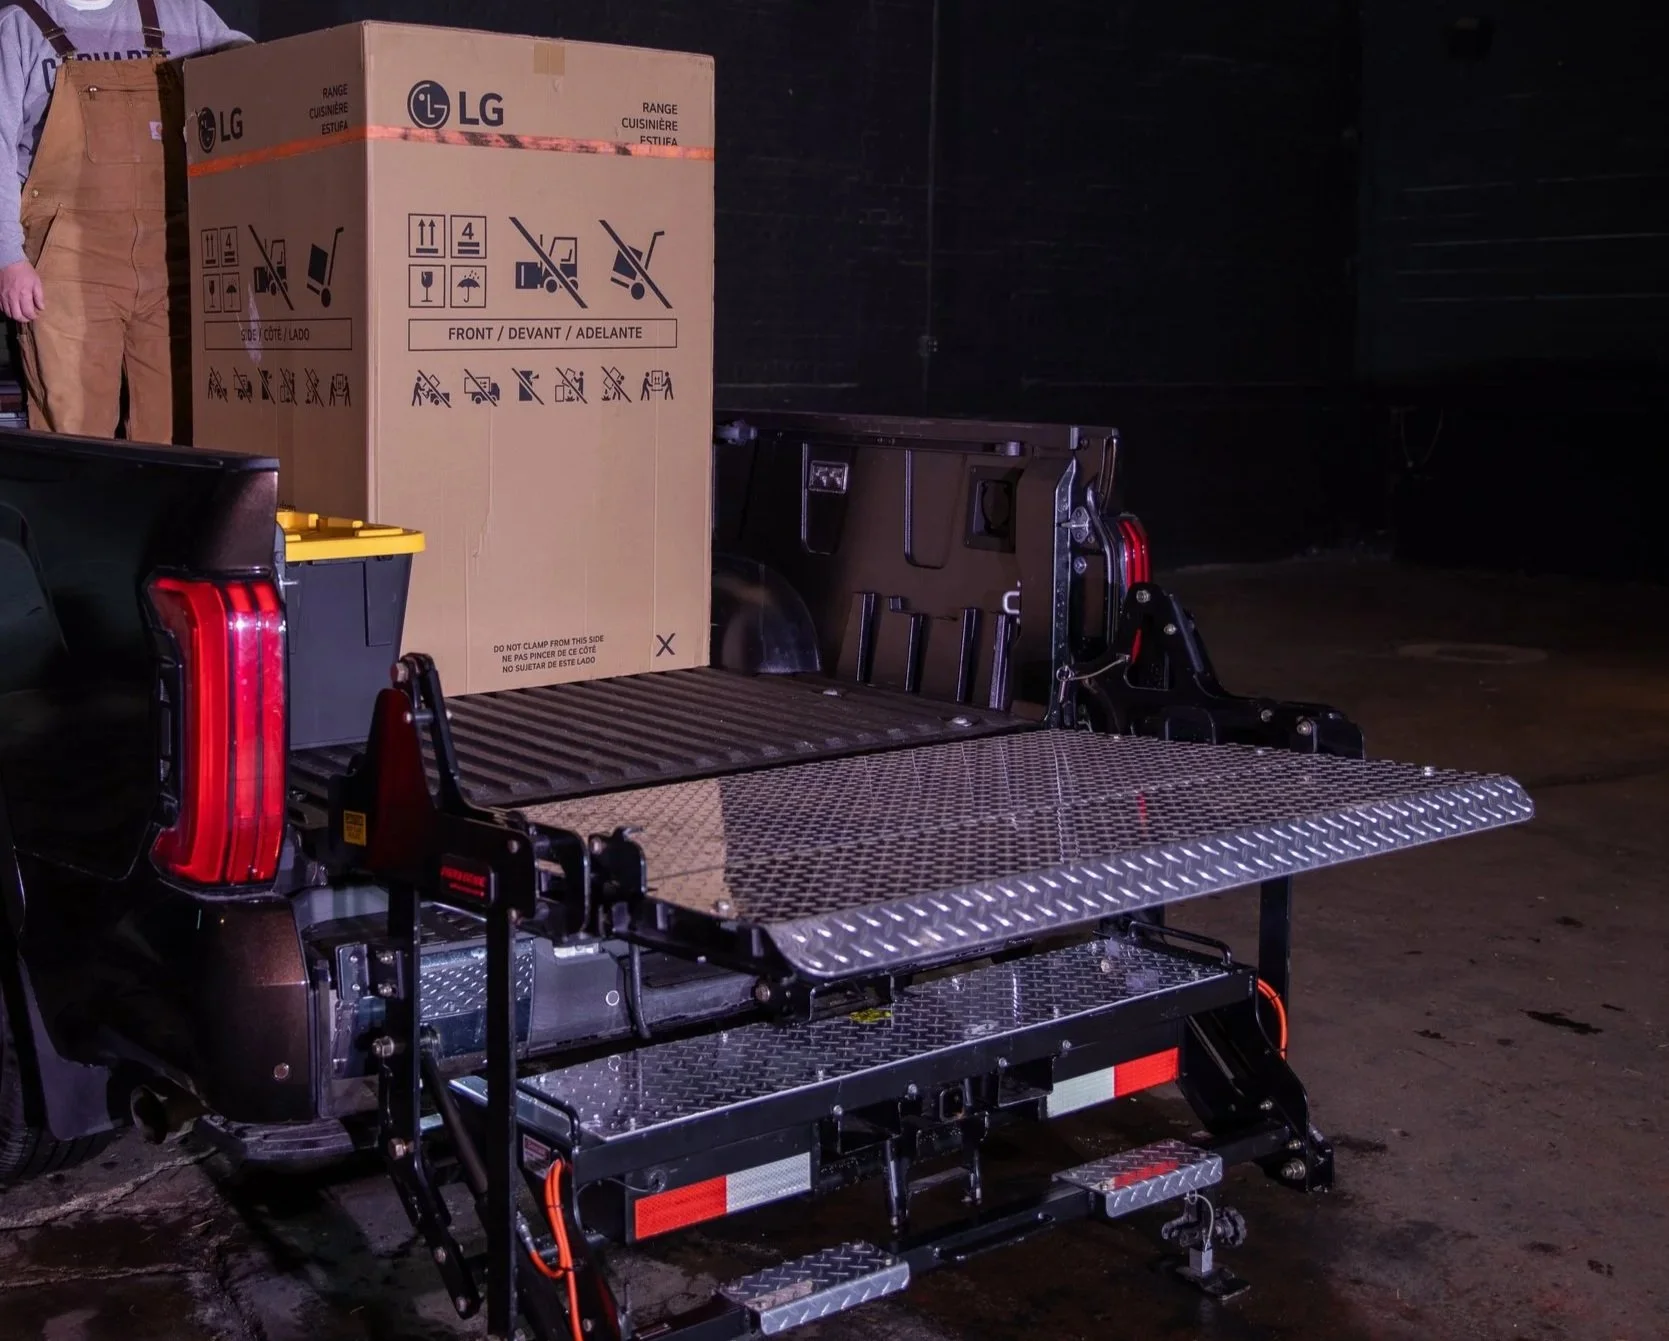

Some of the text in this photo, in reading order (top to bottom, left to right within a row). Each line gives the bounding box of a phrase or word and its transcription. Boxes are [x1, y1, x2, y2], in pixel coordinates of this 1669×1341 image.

[322, 83, 348, 99] RANGE
[308, 101, 348, 120] CUISINIÈRE
[458, 91, 504, 127] LG
[642, 102, 678, 115] RANGE
[219, 107, 243, 142] LG
[321, 120, 348, 135] ESTUFA
[621, 117, 679, 131] CUISINIÈRE
[461, 222, 475, 241] 4
[288, 328, 310, 341] LADO
[448, 325, 643, 342] FRONT / DEVANT / ADELANTE
[493, 634, 604, 653] DO NOT CLAMP FROM THIS SIDE
[502, 655, 512, 663] NE
[514, 653, 528, 661] PAS
[529, 650, 555, 659] PINCER
[557, 649, 566, 657] DE
[568, 648, 577, 656] CE
[502, 656, 596, 673] NO SUJETAR DE ESTE LADO
